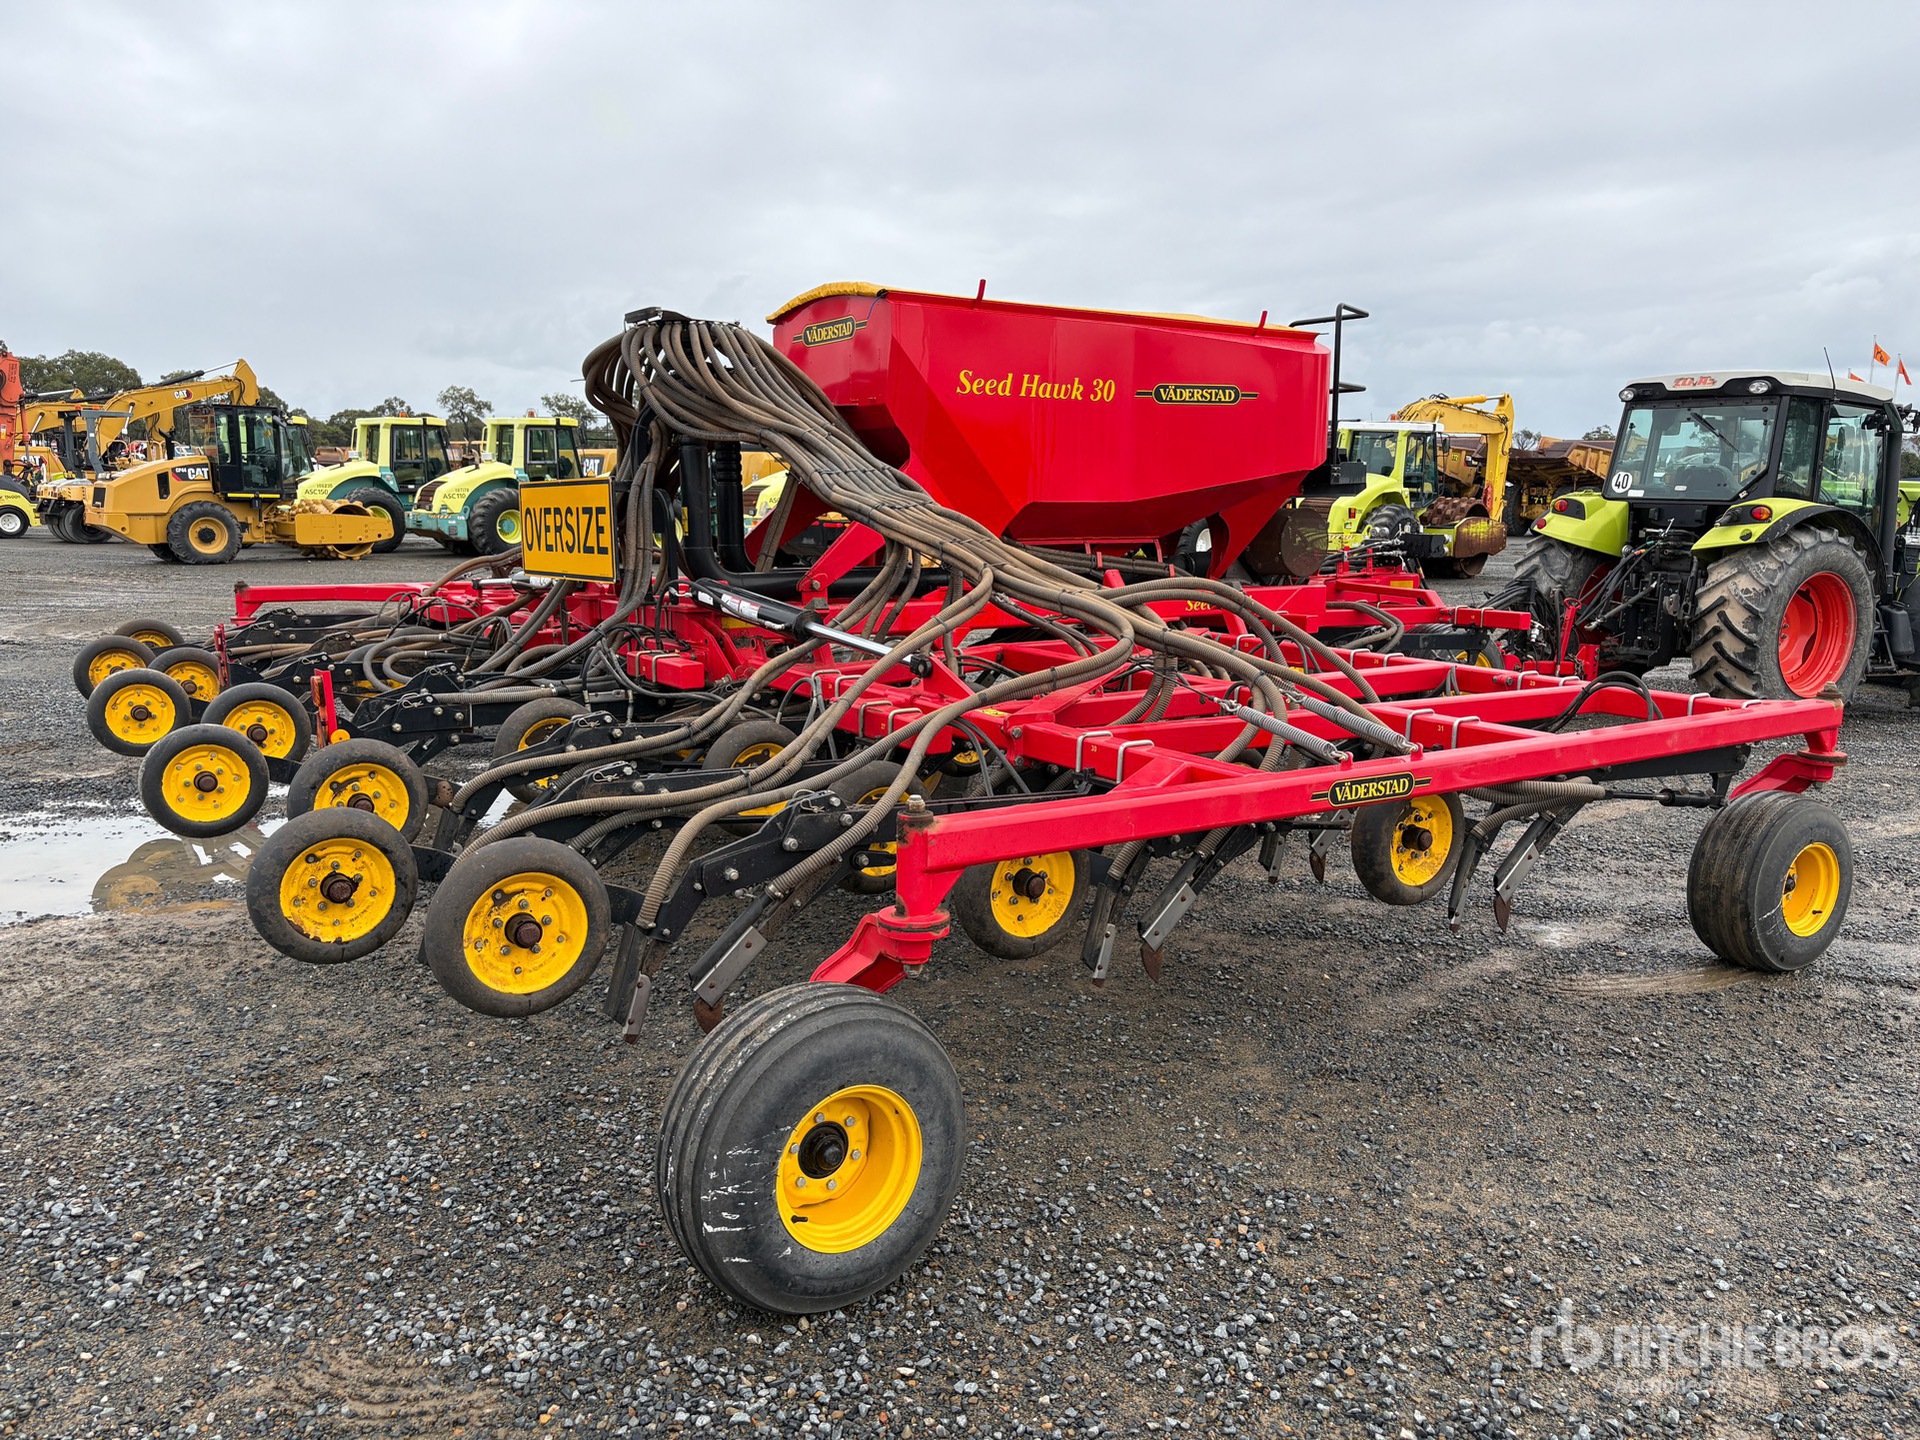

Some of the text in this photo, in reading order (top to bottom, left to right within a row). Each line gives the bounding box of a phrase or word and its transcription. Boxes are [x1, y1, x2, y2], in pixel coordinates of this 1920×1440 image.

[806, 321, 853, 343] VÄDERSTAD
[174, 390, 187, 399] CAT
[956, 369, 1116, 402] Seed Hawk 30
[1159, 385, 1235, 402] VÄDERSTAD
[188, 467, 209, 480] CAT
[583, 458, 600, 477] CAT
[1614, 473, 1629, 490] 40
[524, 506, 609, 555] OVERSIZE
[1185, 600, 1211, 612] See
[1335, 777, 1410, 802] VÄDERSTAD
